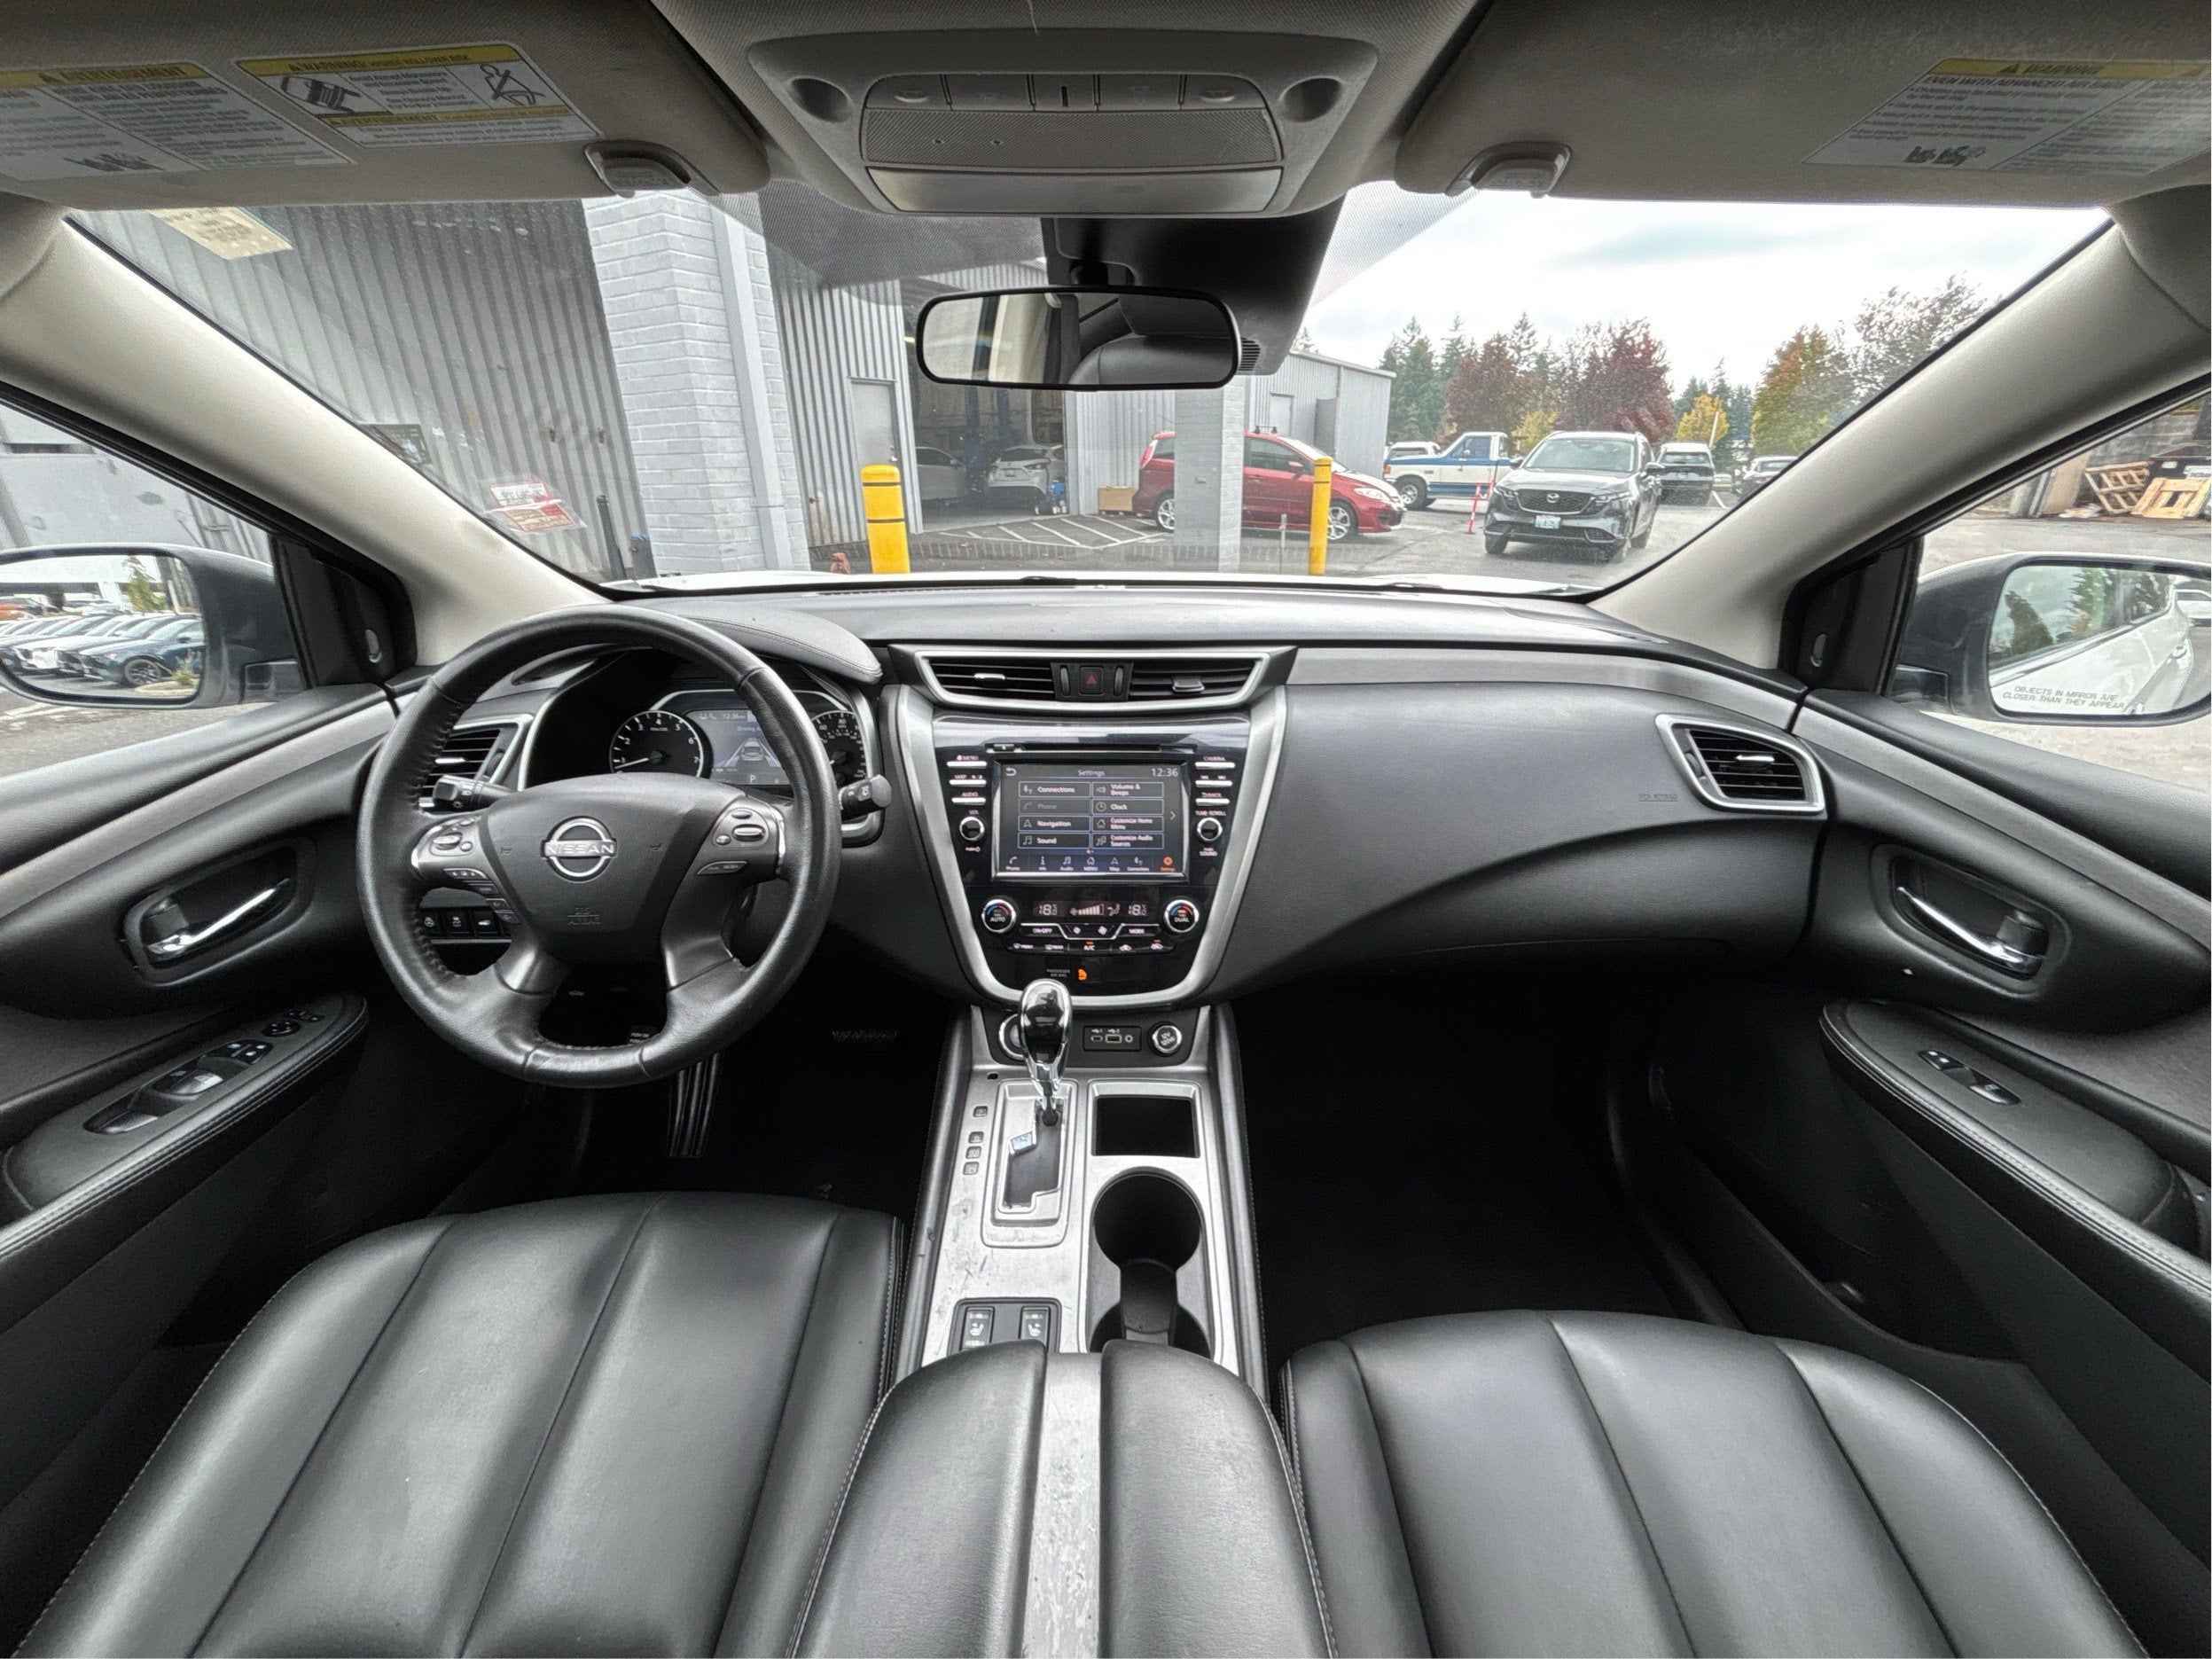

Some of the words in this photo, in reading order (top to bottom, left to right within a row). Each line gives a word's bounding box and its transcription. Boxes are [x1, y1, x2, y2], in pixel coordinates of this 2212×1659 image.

[2014, 685, 2052, 695] OBJECTS
[2066, 691, 2097, 700] MIRROR
[2002, 692, 2036, 701] CLOSER
[2039, 695, 2062, 704] THAN
[2065, 697, 2087, 706] THEY
[2089, 700, 2124, 708] APPEAR
[1151, 768, 1179, 777] 12:36
[749, 774, 756, 784] P
[546, 843, 614, 855] NISSAN
